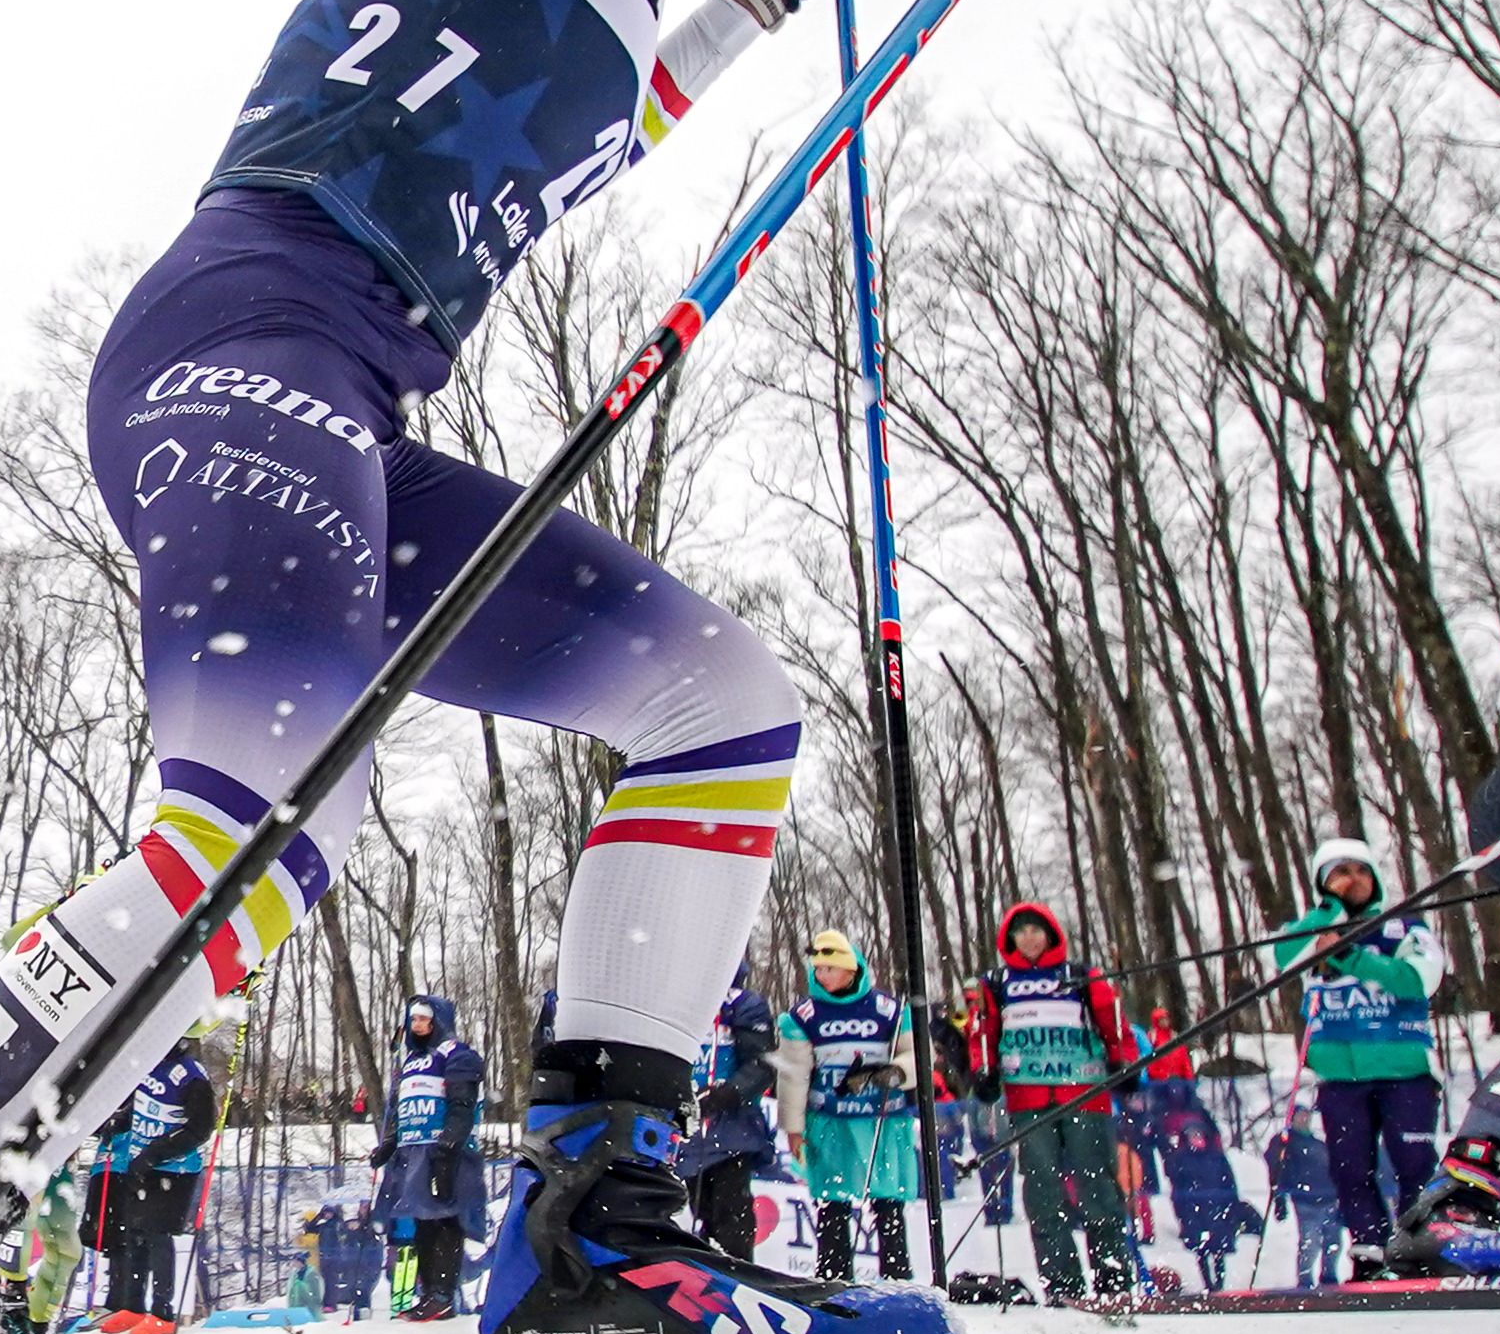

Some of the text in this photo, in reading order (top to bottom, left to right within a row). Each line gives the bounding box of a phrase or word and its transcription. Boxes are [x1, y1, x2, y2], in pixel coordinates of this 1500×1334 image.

[492, 179, 531, 249] Lake
[603, 343, 665, 421] KV+
[209, 440, 318, 486] Residencial
[888, 650, 902, 700] KV+
[22, 940, 92, 1006] NY
[818, 1018, 880, 1038] coop
[1027, 1061, 1073, 1078] CAN
[131, 1113, 166, 1138] EAM
[399, 1098, 436, 1120] EAM
